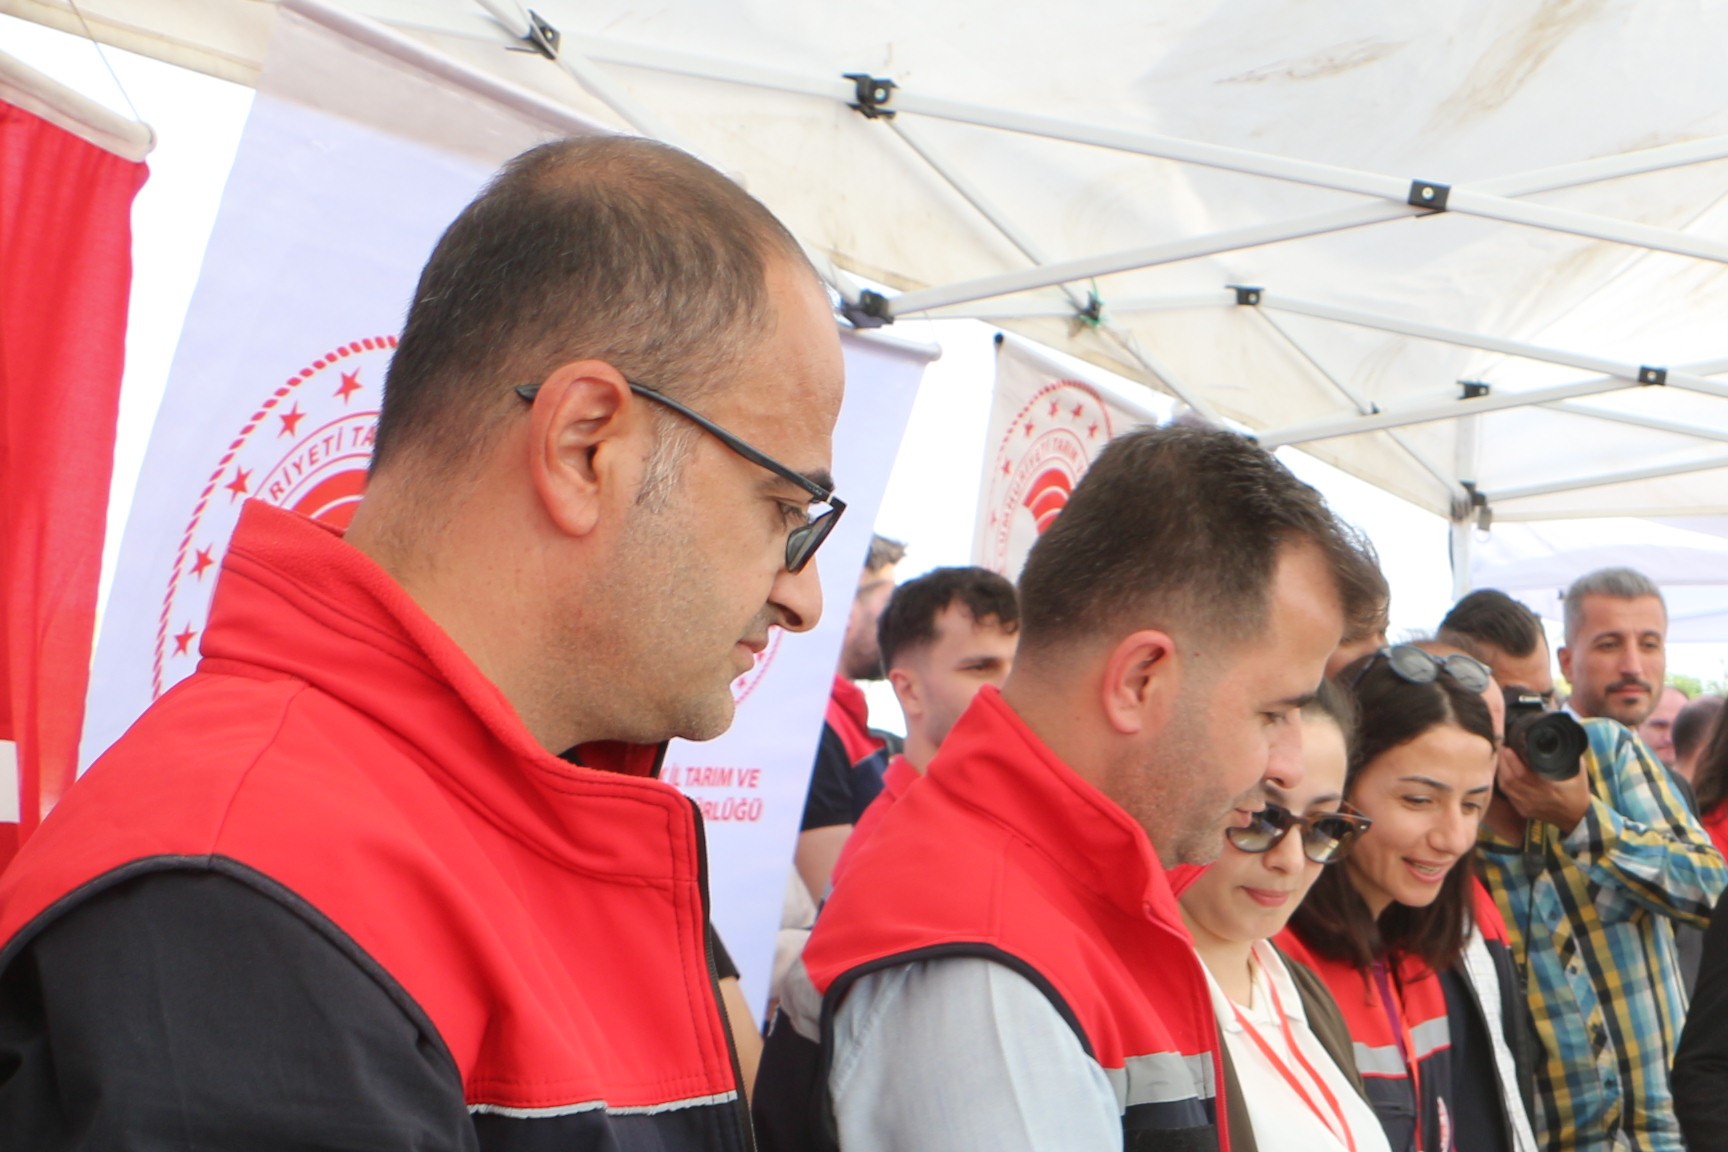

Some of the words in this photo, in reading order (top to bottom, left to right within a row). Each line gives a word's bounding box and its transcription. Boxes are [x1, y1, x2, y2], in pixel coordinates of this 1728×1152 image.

[269, 426, 343, 501] RİYETİ
[352, 426, 378, 447] TA
[685, 767, 733, 787] TARIM
[738, 767, 761, 787] VE
[701, 797, 763, 821] RLÜĞÜ
